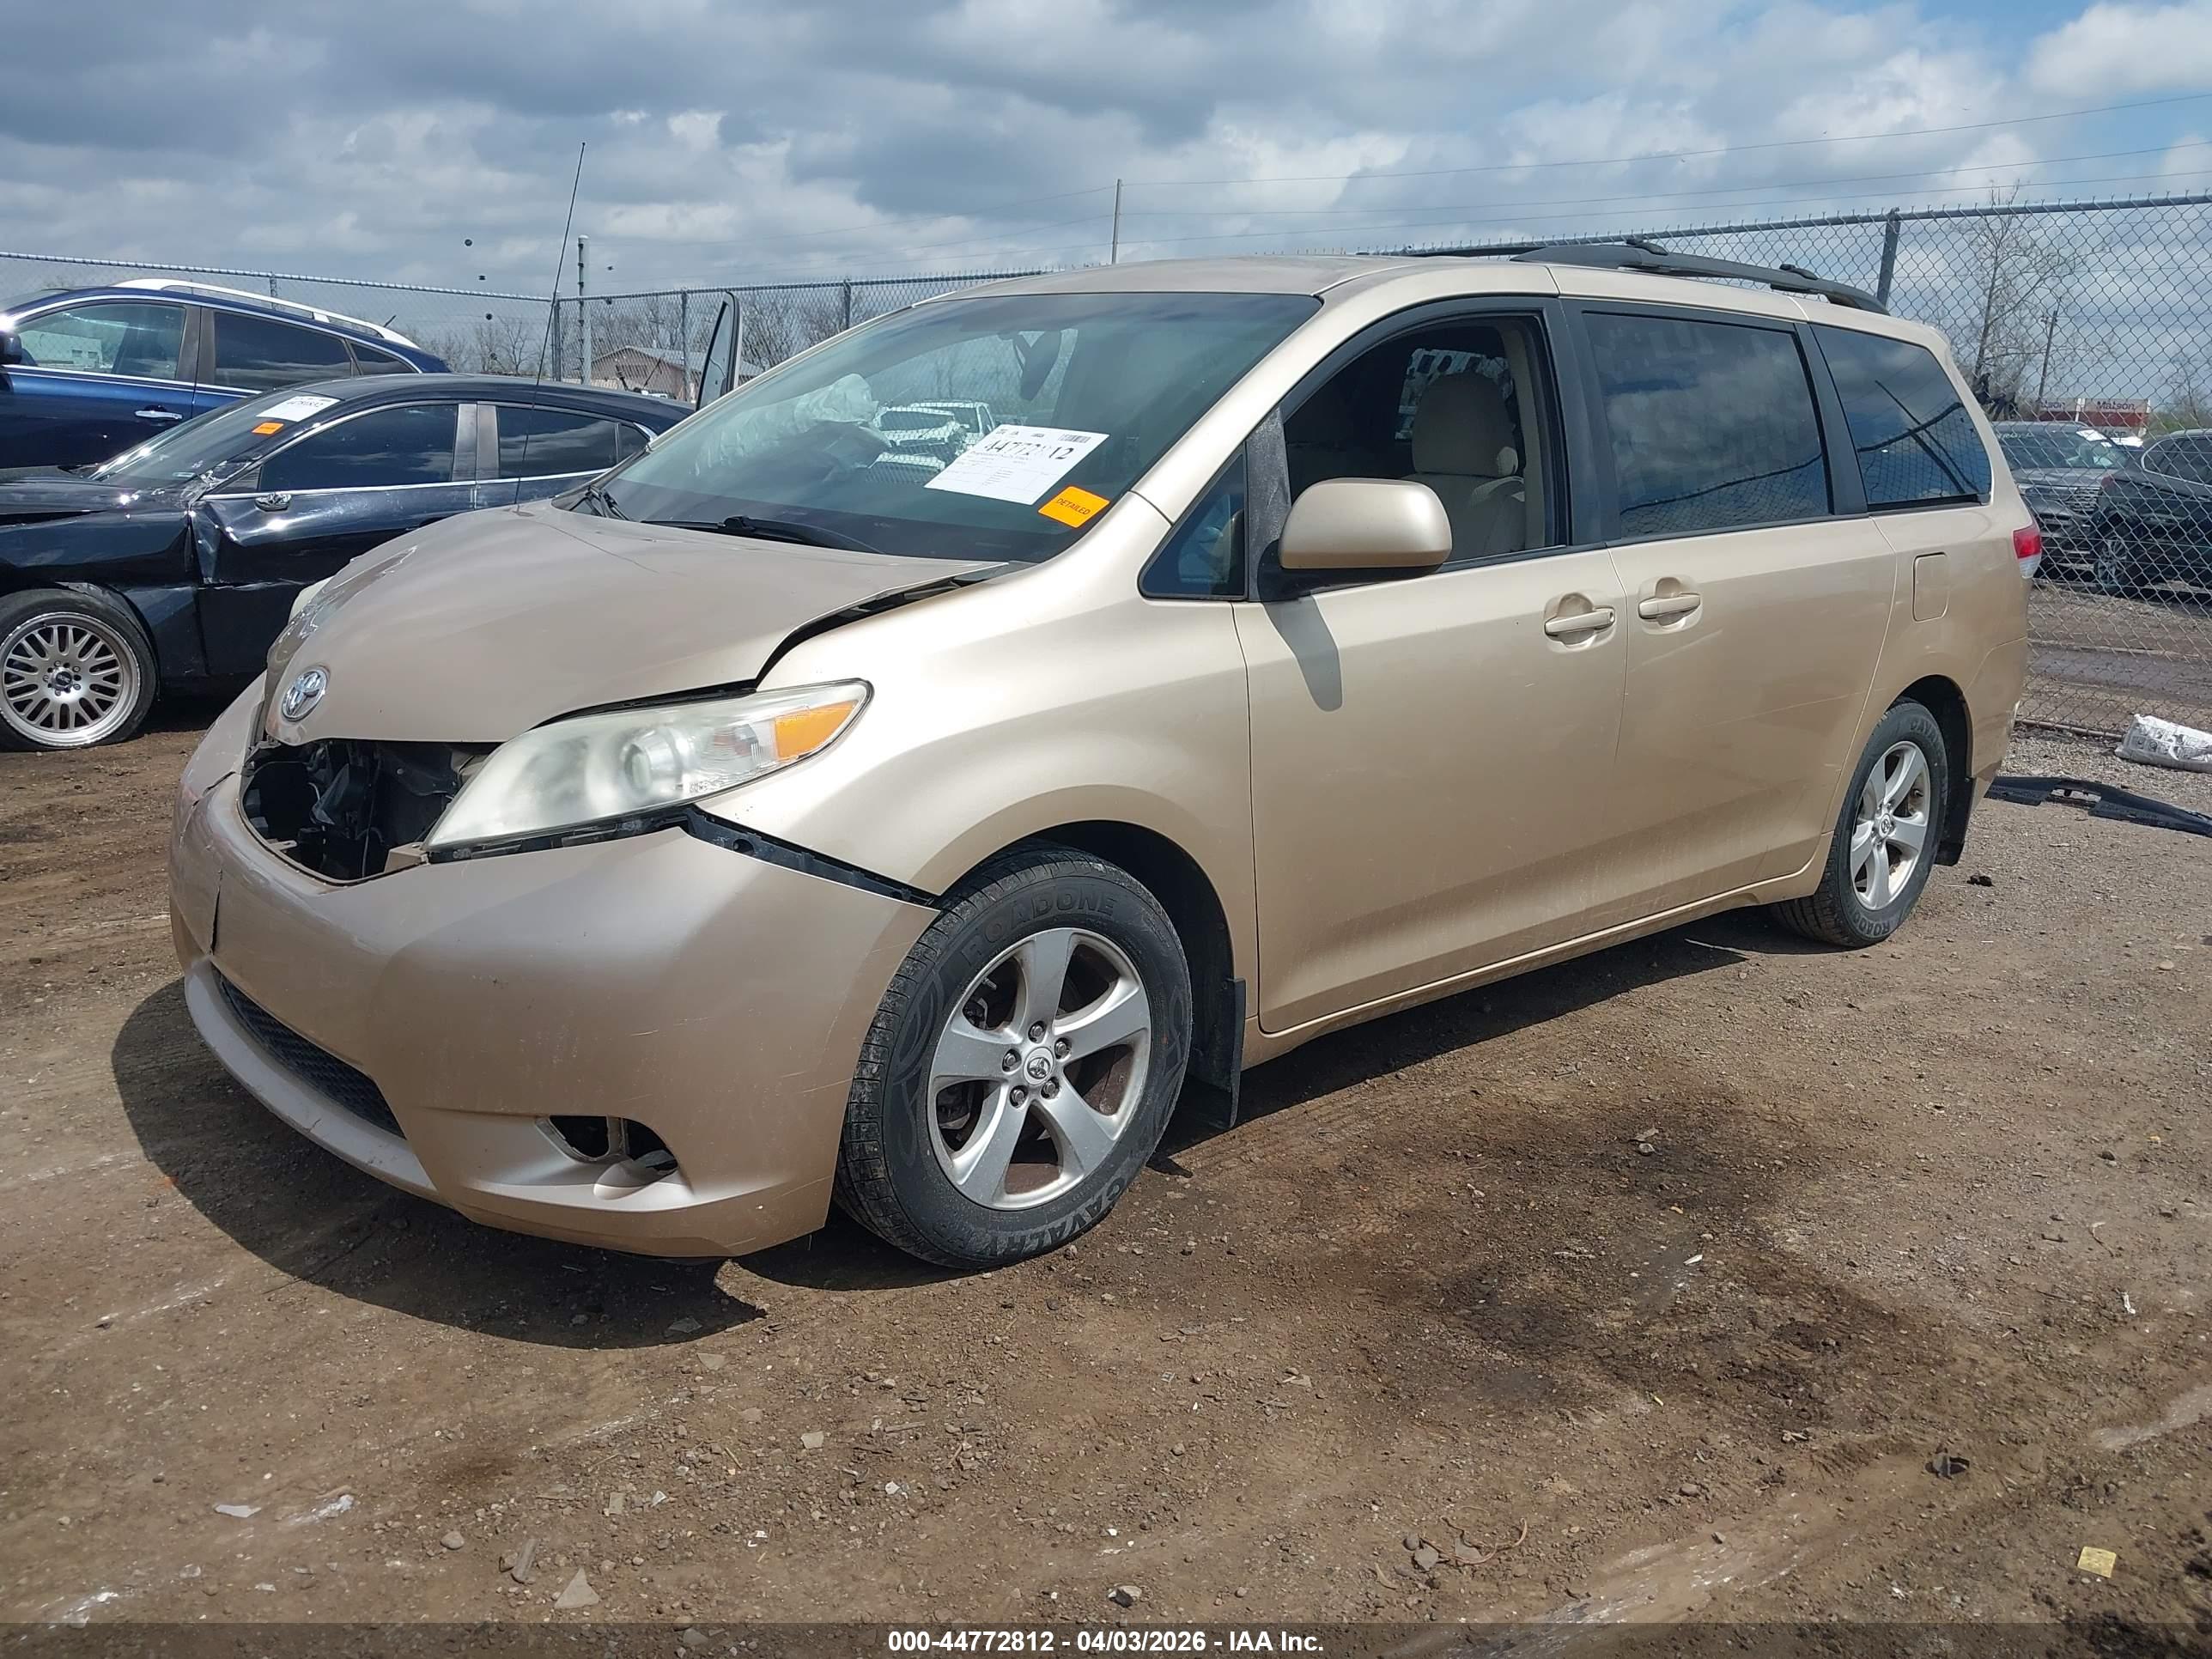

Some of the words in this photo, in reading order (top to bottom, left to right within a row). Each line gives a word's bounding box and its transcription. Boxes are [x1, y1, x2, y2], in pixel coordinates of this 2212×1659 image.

[2097, 401, 2136, 410] Matson
[1056, 497, 1091, 515] DETAILED
[961, 886, 1118, 966] ROADONE
